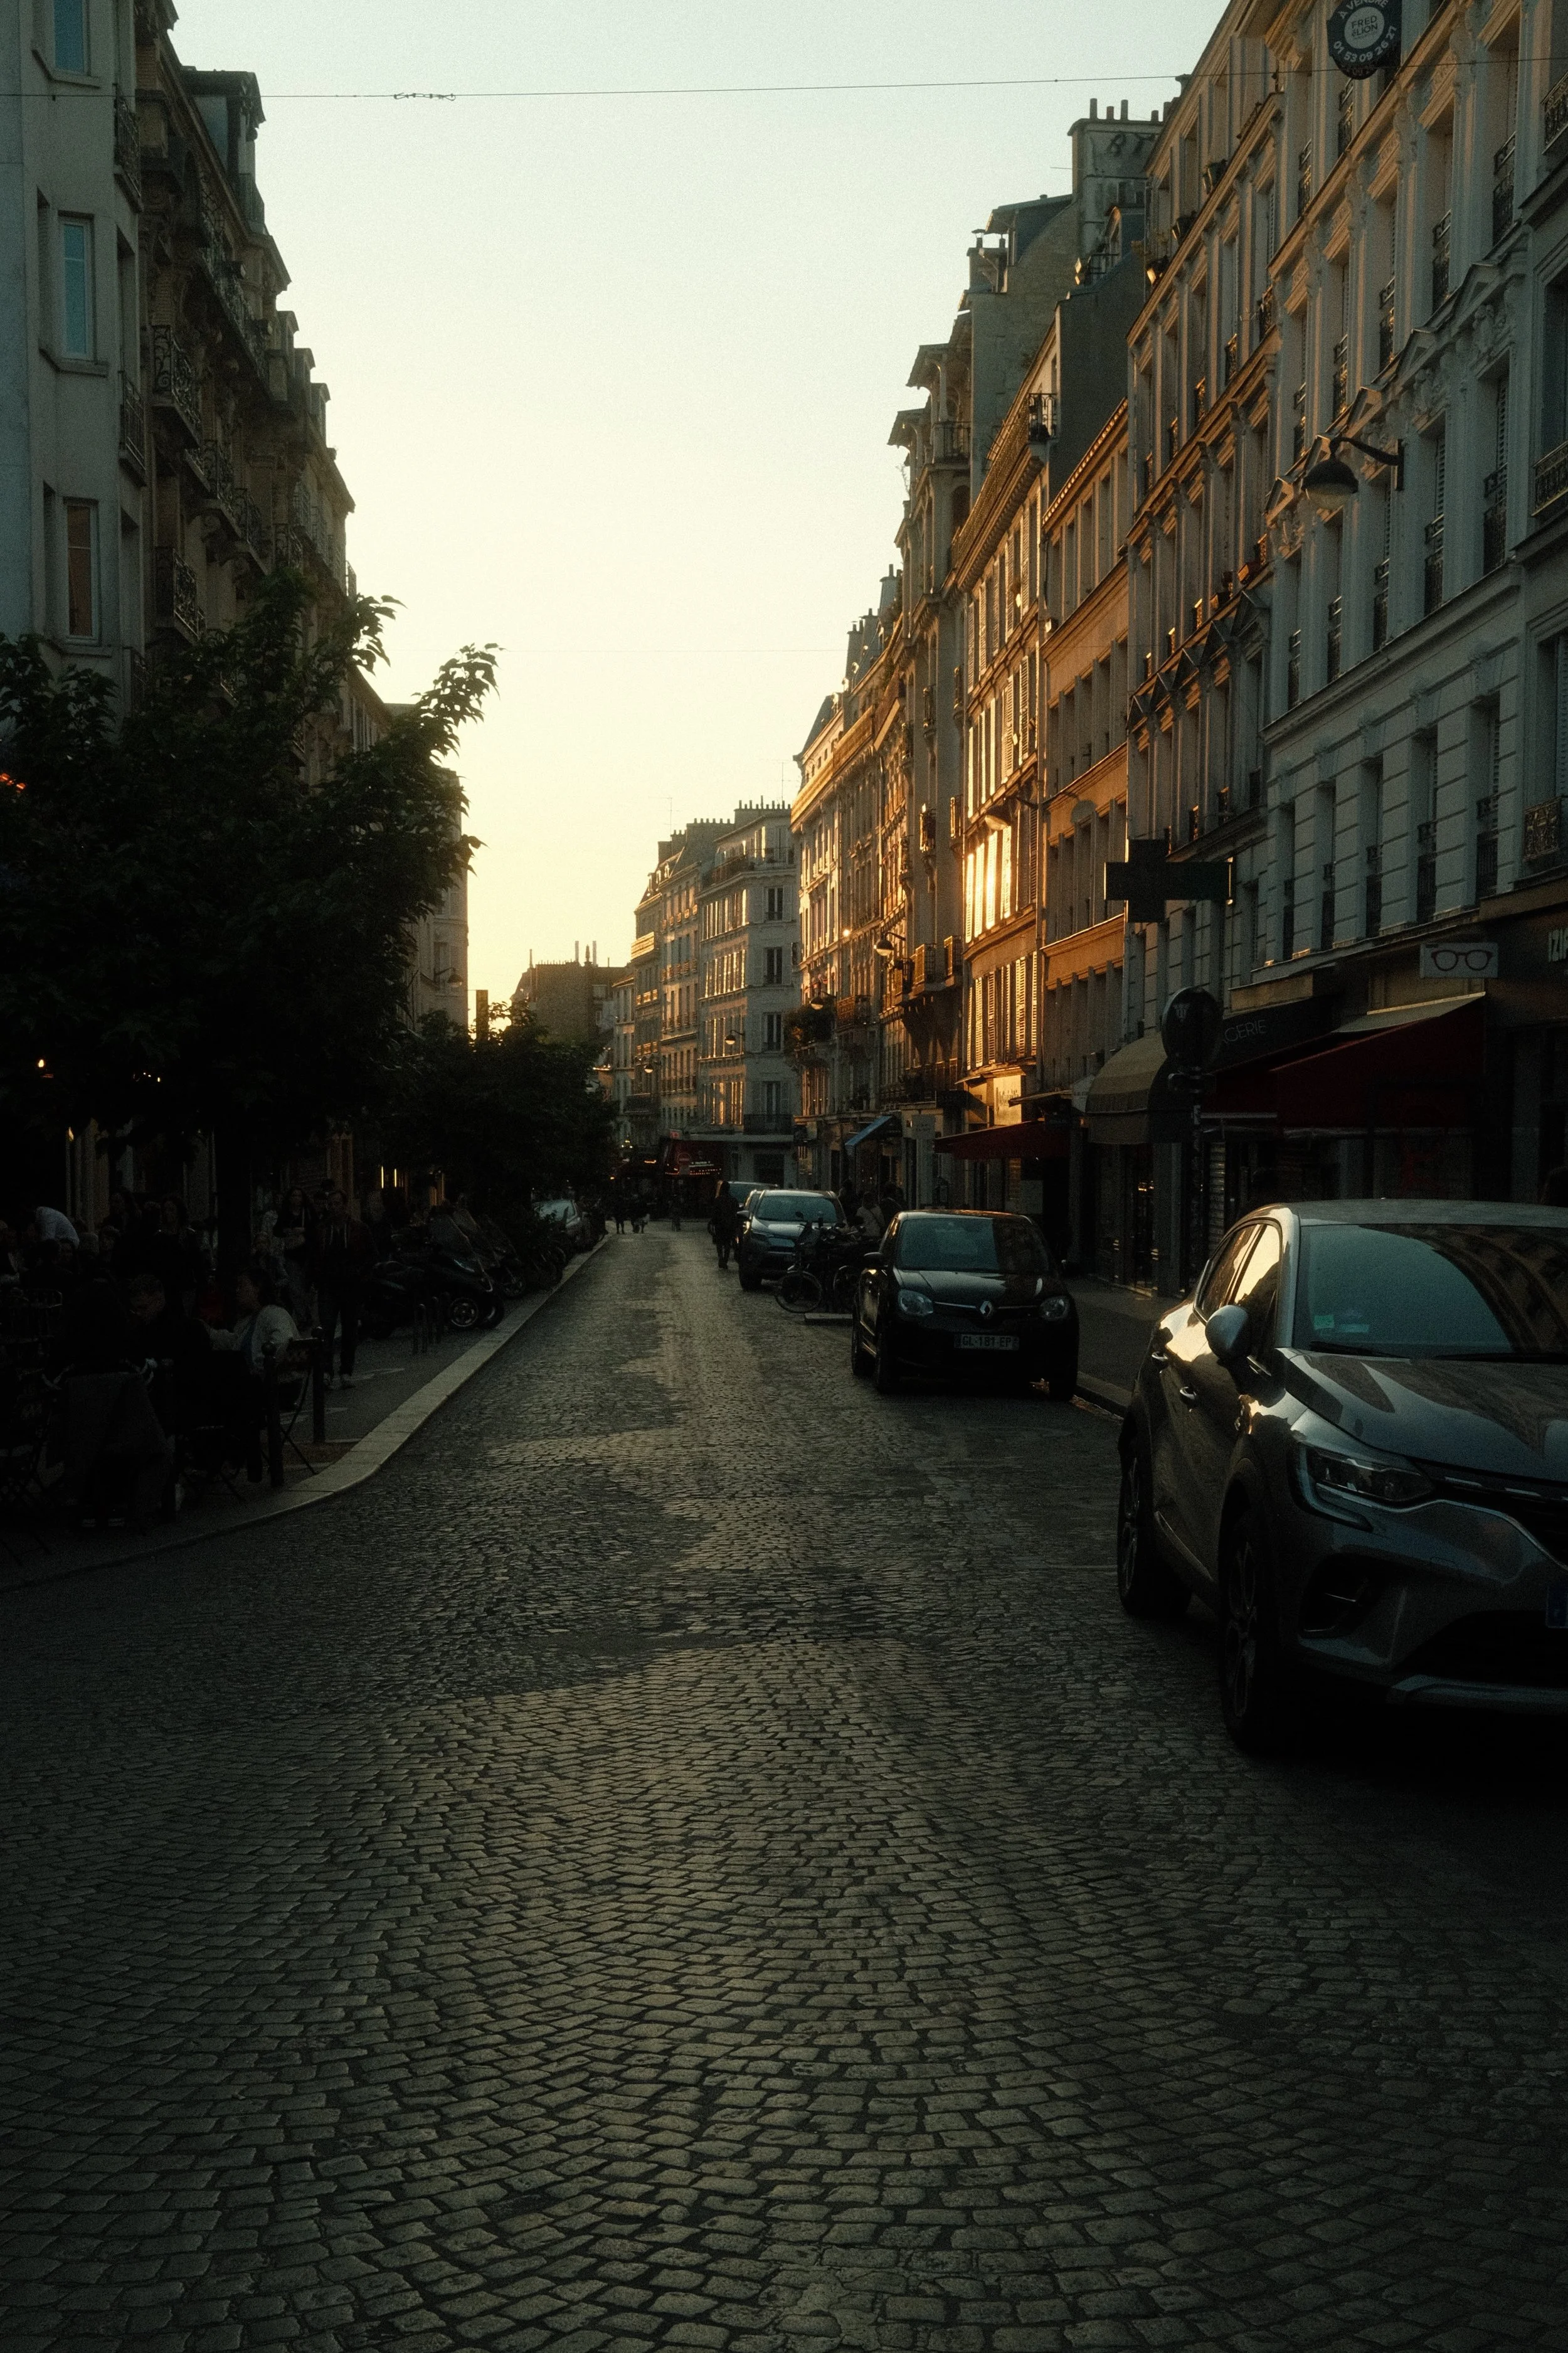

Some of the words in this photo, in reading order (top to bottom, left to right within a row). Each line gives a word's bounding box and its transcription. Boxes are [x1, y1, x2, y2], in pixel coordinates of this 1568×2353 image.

[1352, 15, 1377, 29] FRED
[1333, 41, 1345, 55] 01
[1343, 51, 1357, 63] 53
[1359, 51, 1374, 63] 09
[1374, 40, 1389, 55] 26
[1384, 25, 1397, 40] 27
[1224, 1019, 1267, 1044] GERIE
